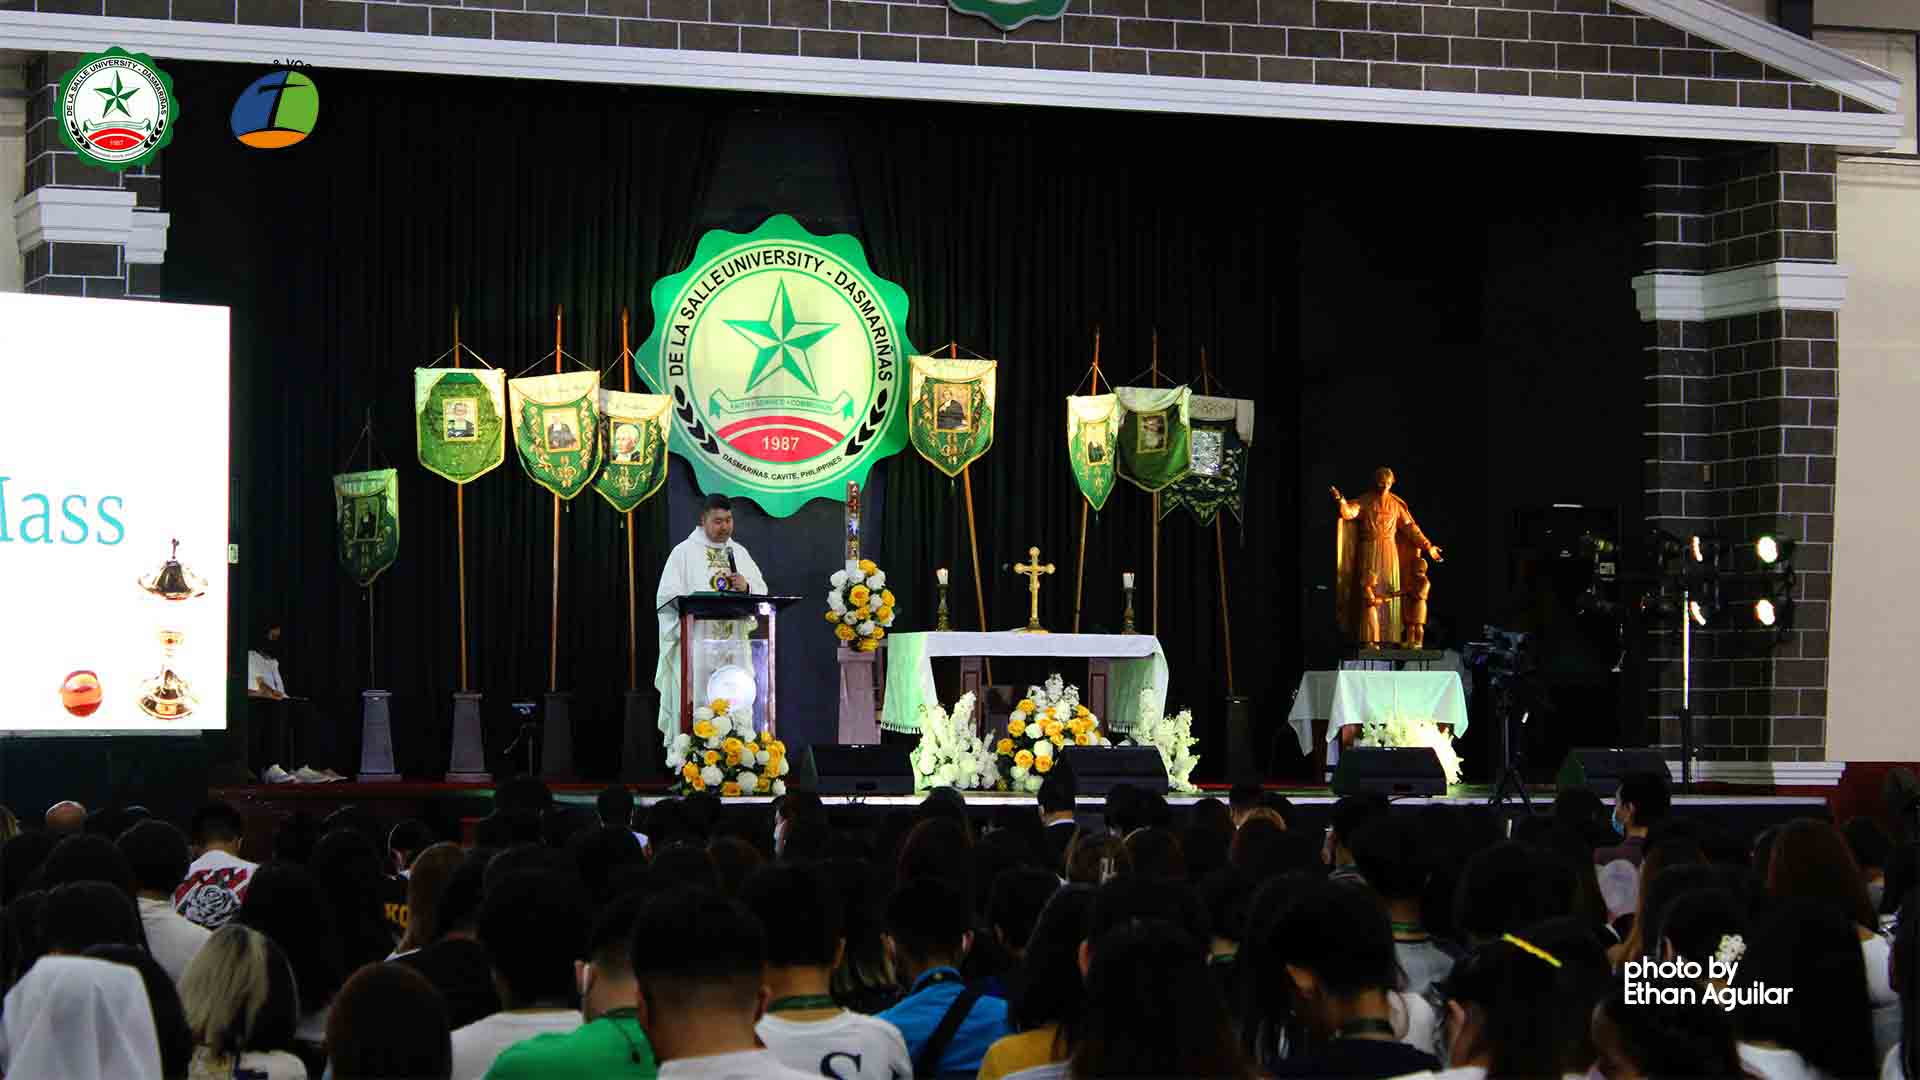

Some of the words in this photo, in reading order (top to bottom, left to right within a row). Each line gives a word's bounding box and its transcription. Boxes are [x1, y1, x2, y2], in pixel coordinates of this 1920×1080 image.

[721, 250, 825, 278] UNIVERSITY
[680, 269, 725, 320] SALLE
[671, 324, 690, 346] LA
[669, 352, 684, 376] DE
[761, 436, 800, 451] 1987
[0, 476, 126, 545] ass
